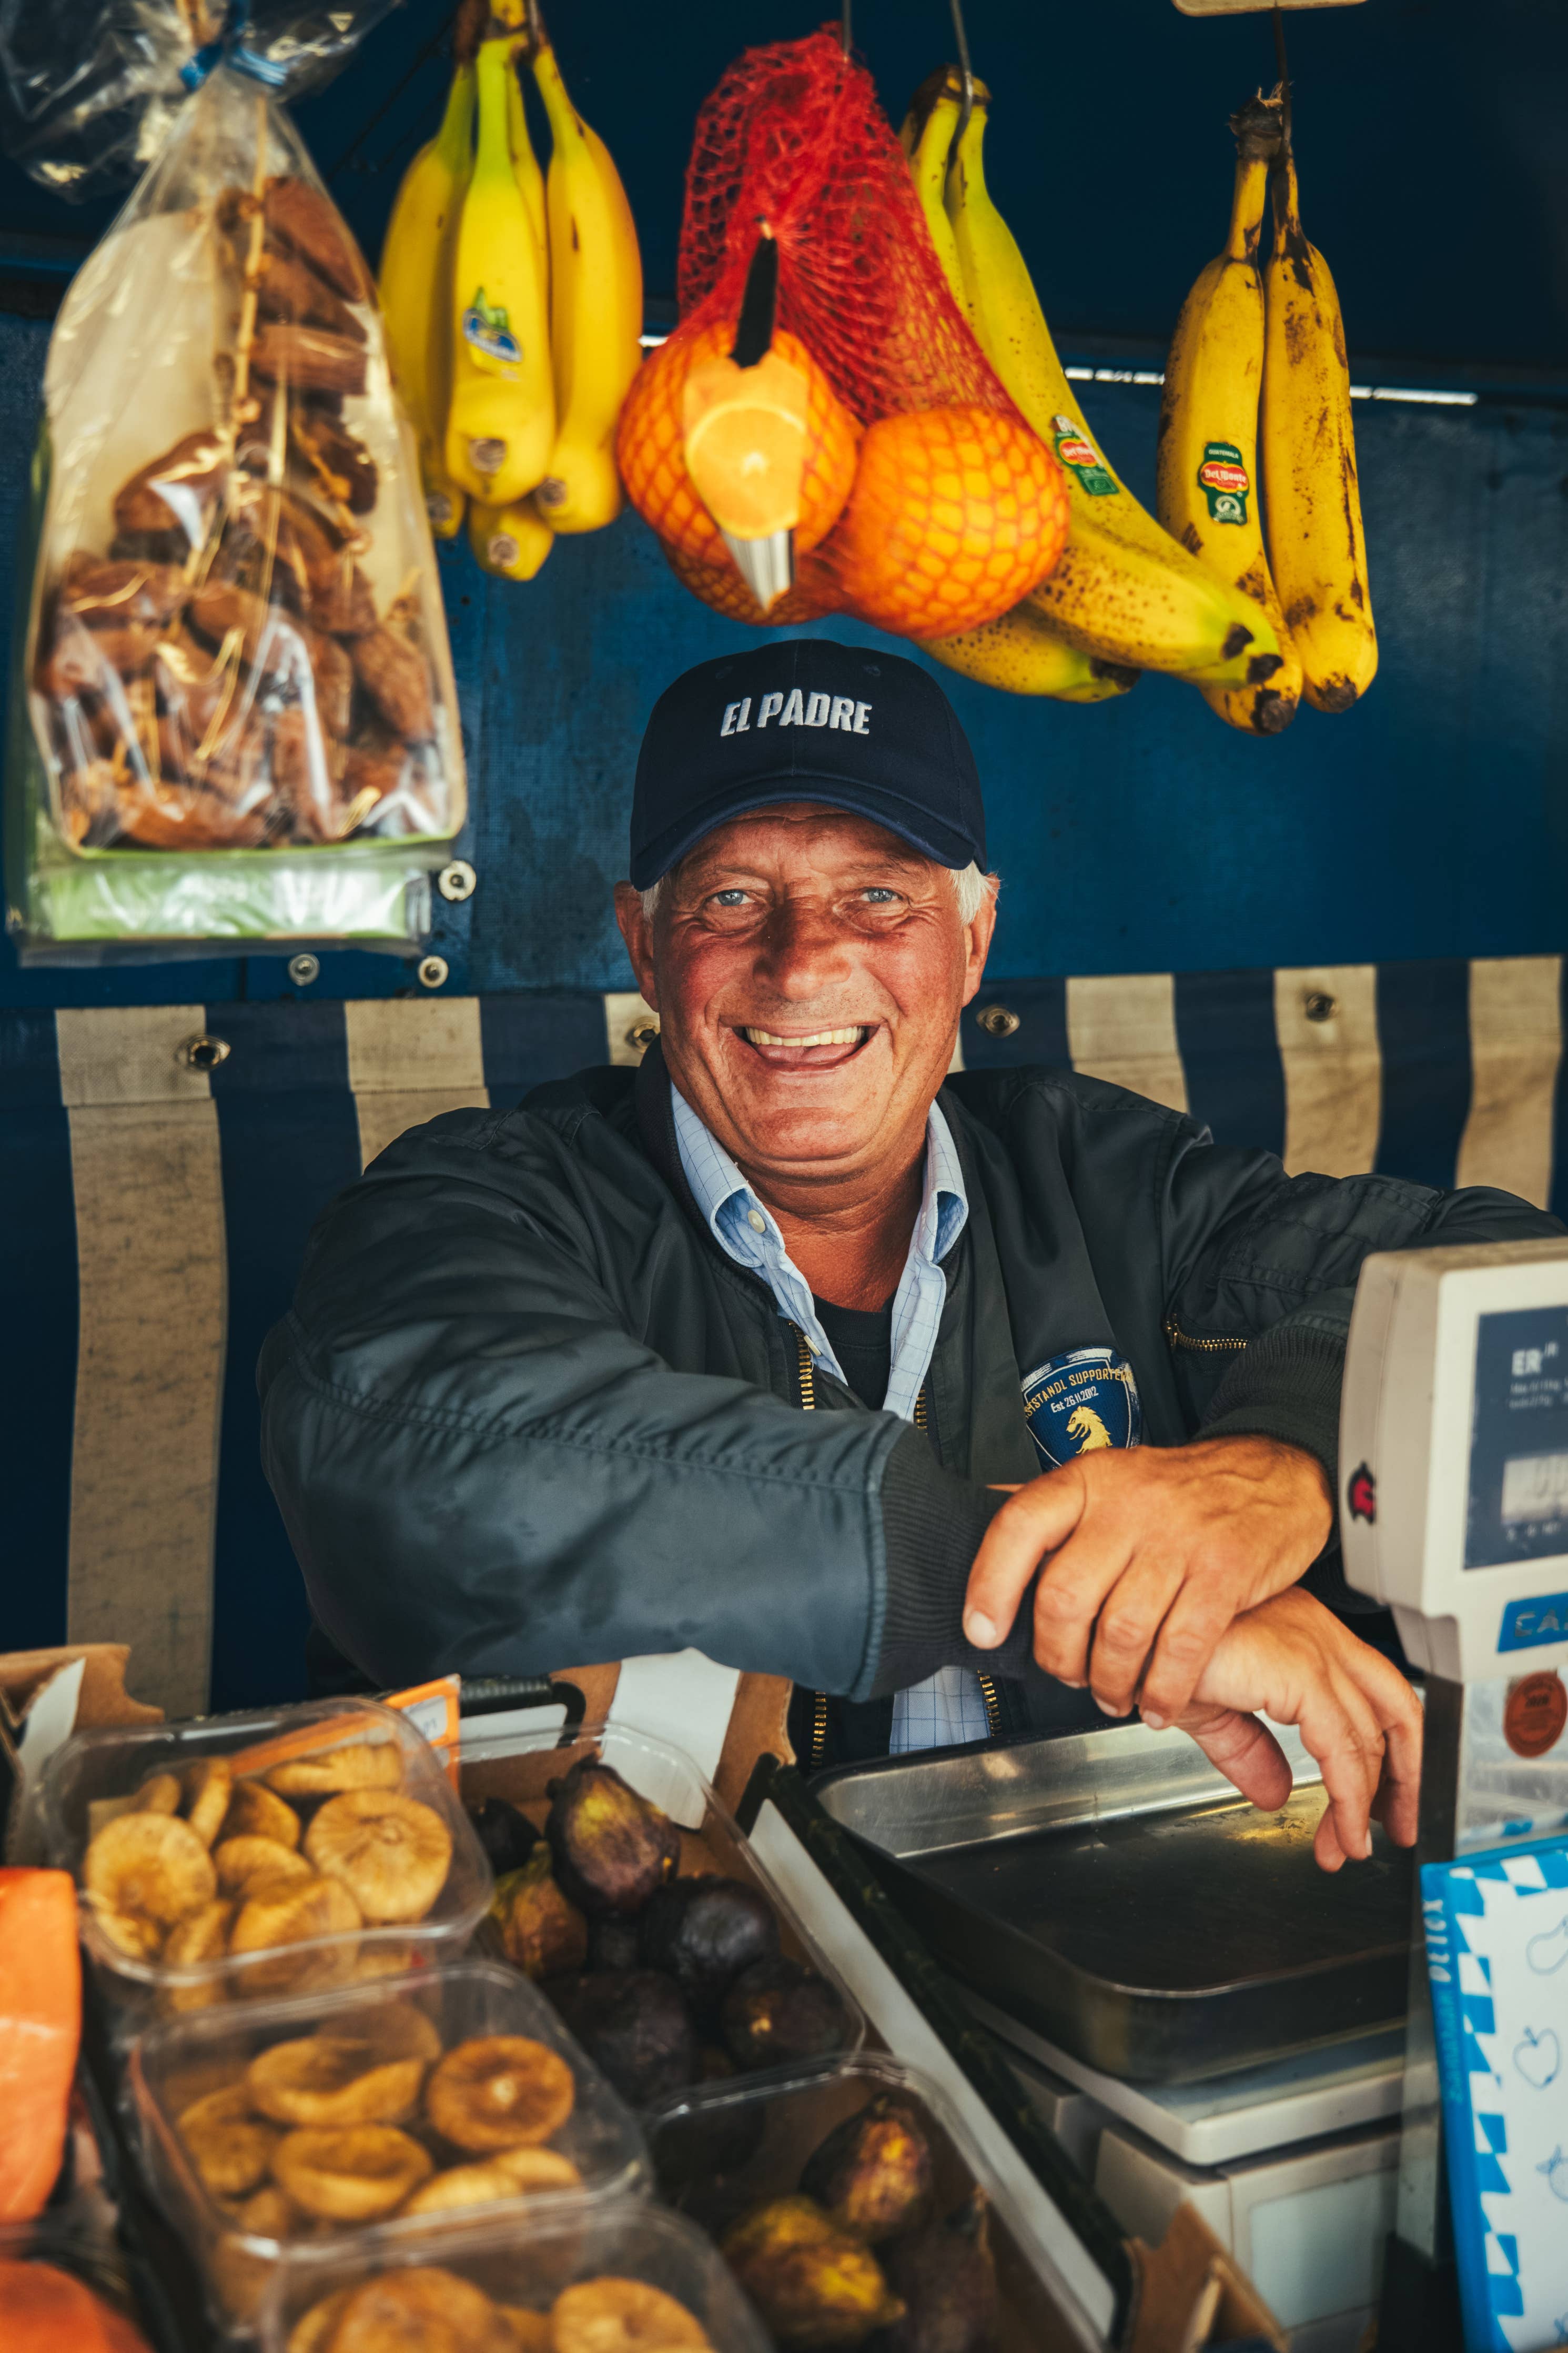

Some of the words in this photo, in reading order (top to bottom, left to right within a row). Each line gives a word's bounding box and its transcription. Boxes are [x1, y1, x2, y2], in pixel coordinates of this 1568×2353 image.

[1208, 449, 1239, 459] GUATEMALA
[1204, 469, 1221, 480] Del
[1220, 470, 1246, 484] Monte
[721, 697, 752, 737] EL
[757, 688, 873, 735] PADRE
[1024, 1379, 1068, 1419] STSTANDL
[1050, 1401, 1066, 1413] Est
